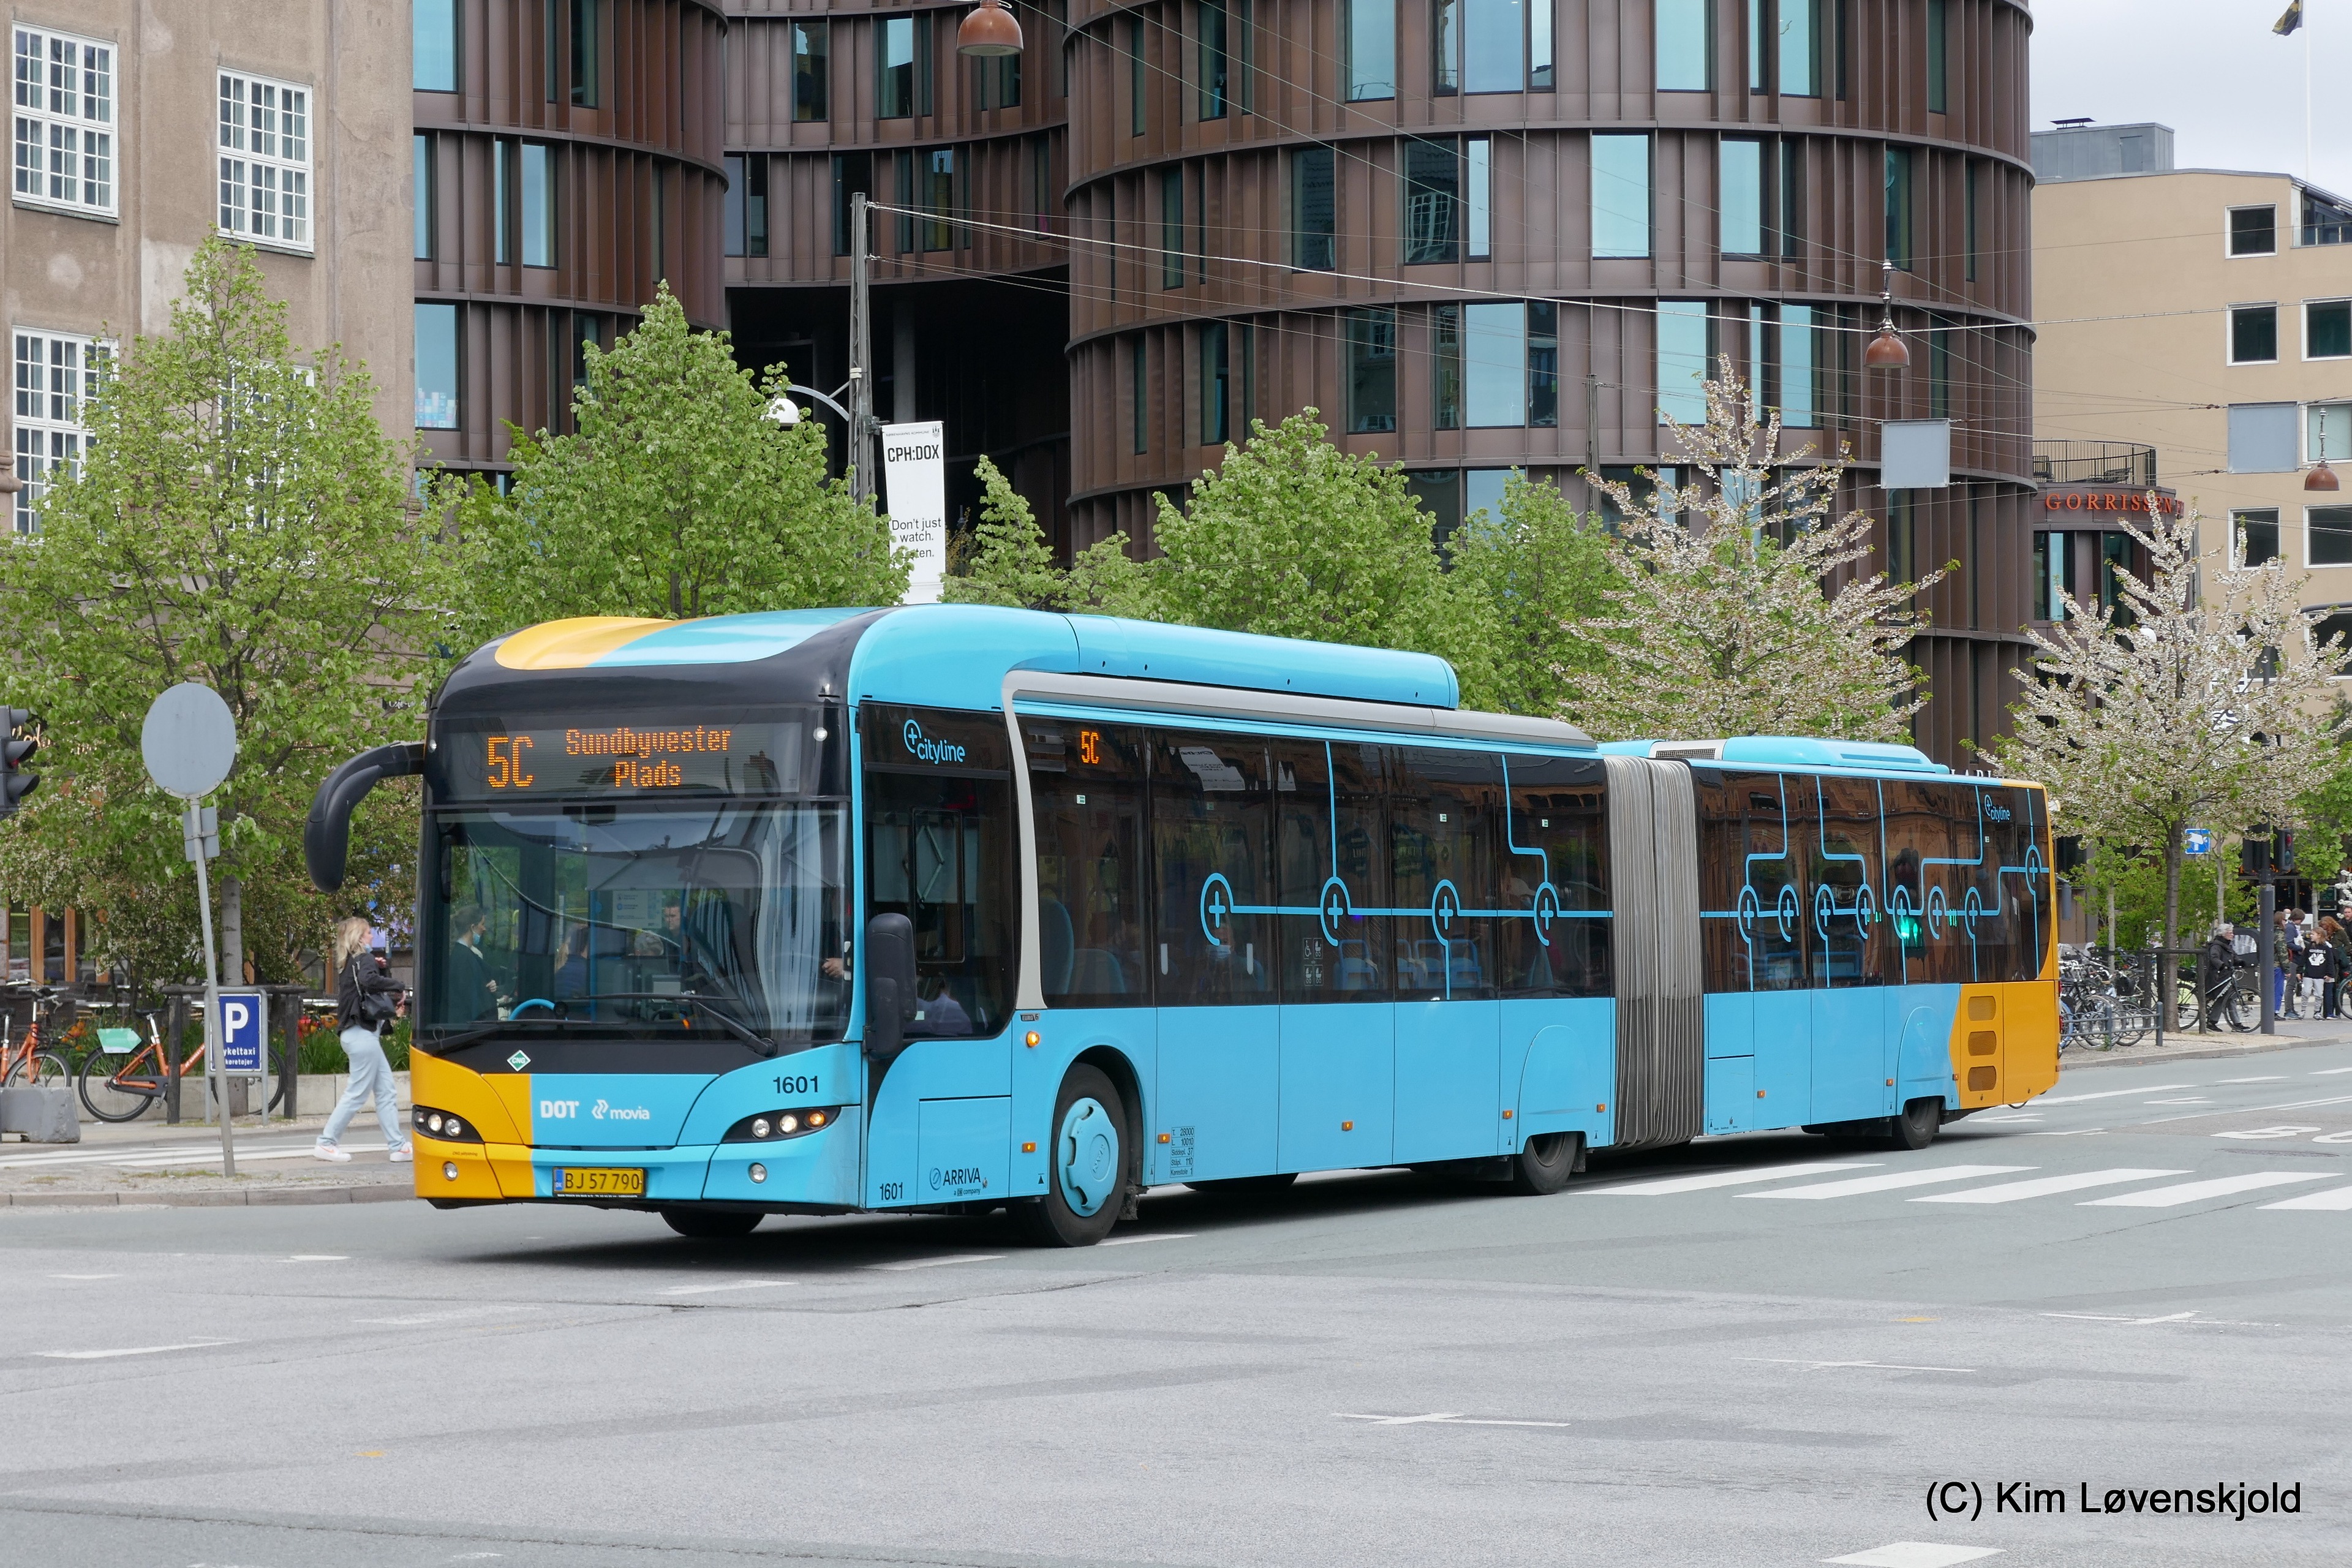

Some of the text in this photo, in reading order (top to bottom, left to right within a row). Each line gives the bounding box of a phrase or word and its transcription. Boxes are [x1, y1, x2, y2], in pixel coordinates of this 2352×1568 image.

[888, 445, 940, 462] CPH:DOX
[892, 518, 941, 532] Don't just
[899, 530, 934, 543] watch.
[565, 725, 731, 758] Sundbyvester
[1081, 731, 1100, 764] 5C
[918, 739, 966, 765] cityline
[488, 736, 534, 788] 5C
[614, 760, 682, 787] Plads
[1990, 806, 2010, 823] cityline
[225, 1003, 249, 1043] P
[223, 1047, 256, 1057] ykeltaxi
[773, 1076, 819, 1094] 1601
[540, 1101, 579, 1118] DOT
[610, 1106, 650, 1120] movia
[1180, 1128, 1194, 1136] 28000
[1181, 1137, 1194, 1146] 10010
[1187, 1147, 1193, 1156] 37
[565, 1173, 639, 1190] BJ 57 790
[943, 1167, 981, 1186] ARRIVA
[880, 1182, 903, 1200] 1601
